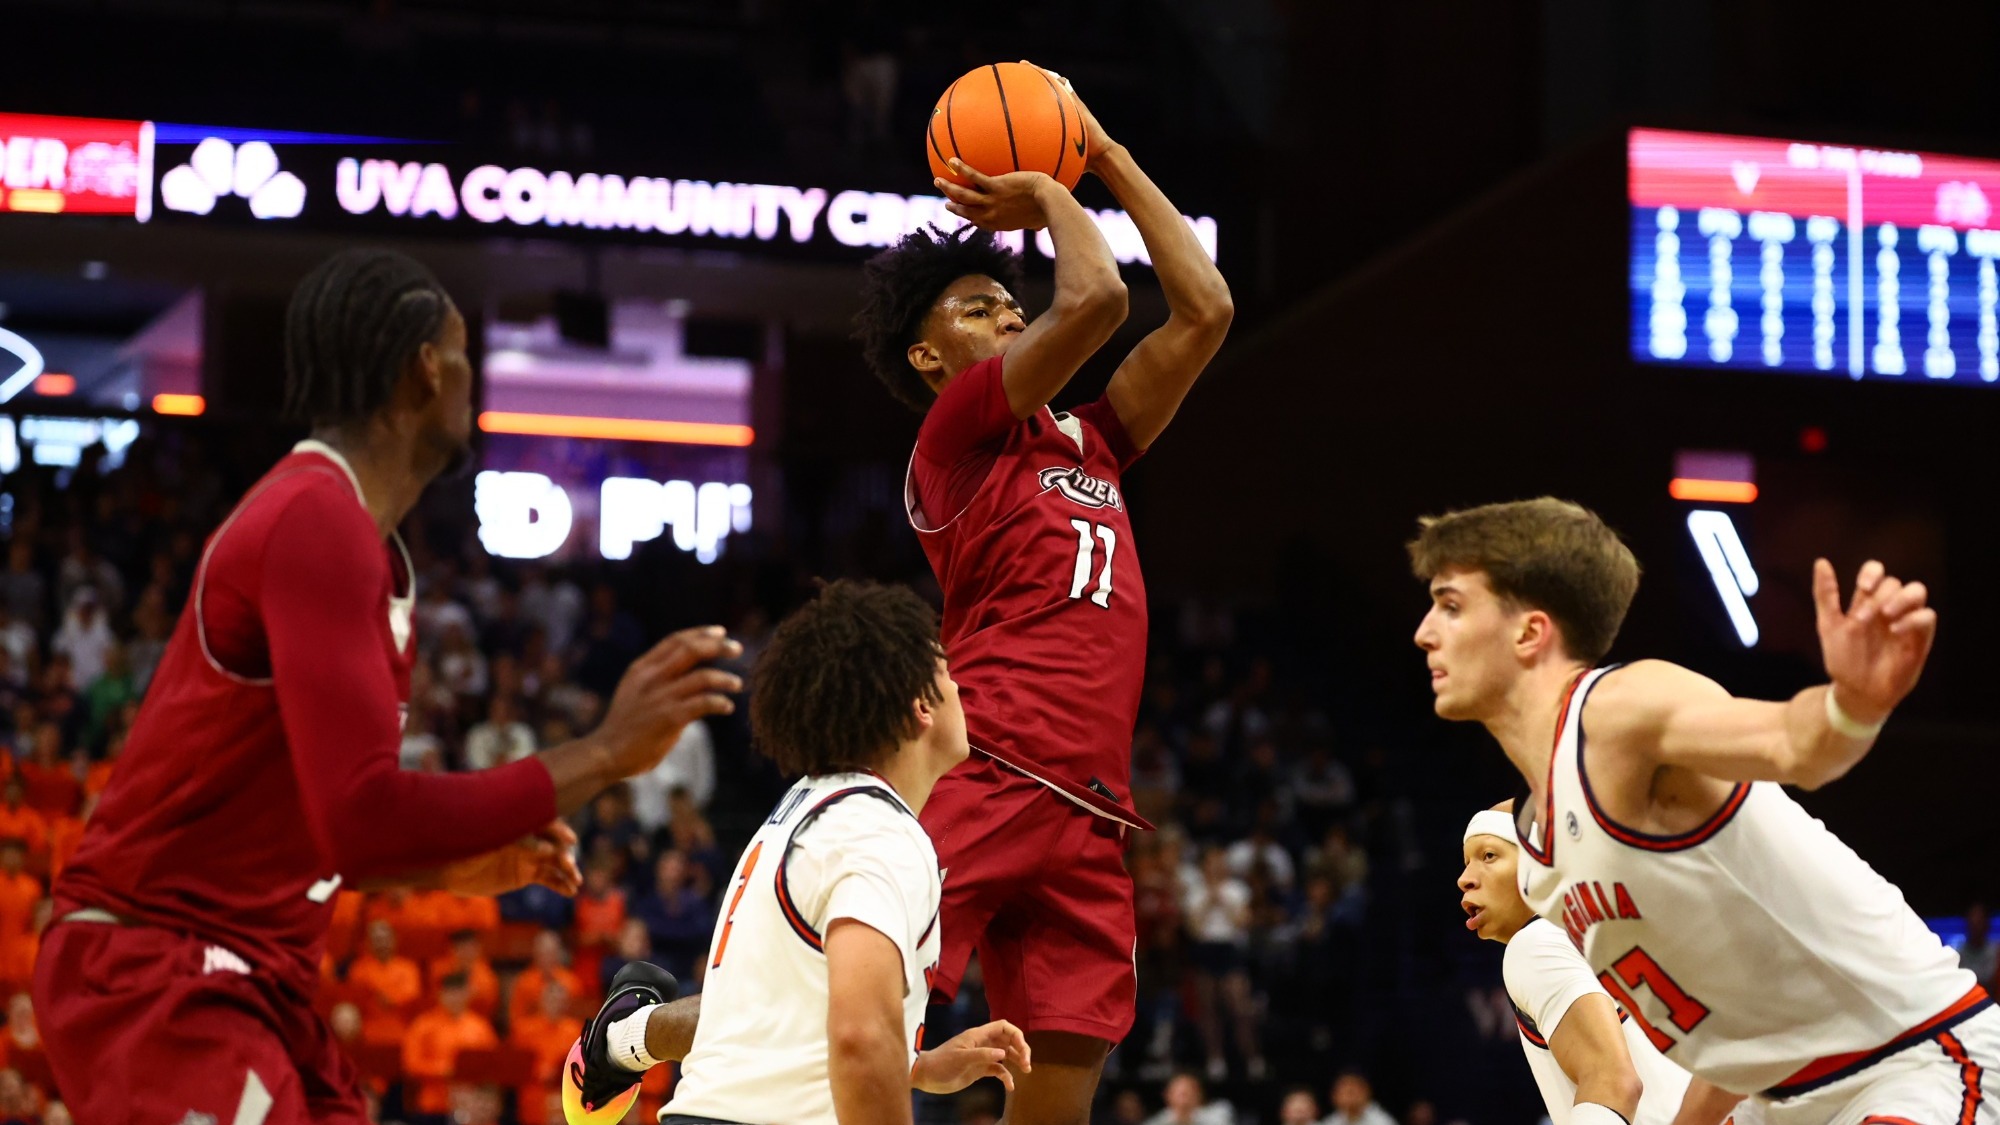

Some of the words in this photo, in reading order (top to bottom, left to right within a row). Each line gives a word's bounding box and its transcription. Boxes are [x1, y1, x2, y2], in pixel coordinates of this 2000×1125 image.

[336, 157, 457, 217] UVA
[461, 165, 828, 241] COMMUNITY
[1069, 517, 1117, 609] 11
[1597, 945, 1711, 1054] 17
